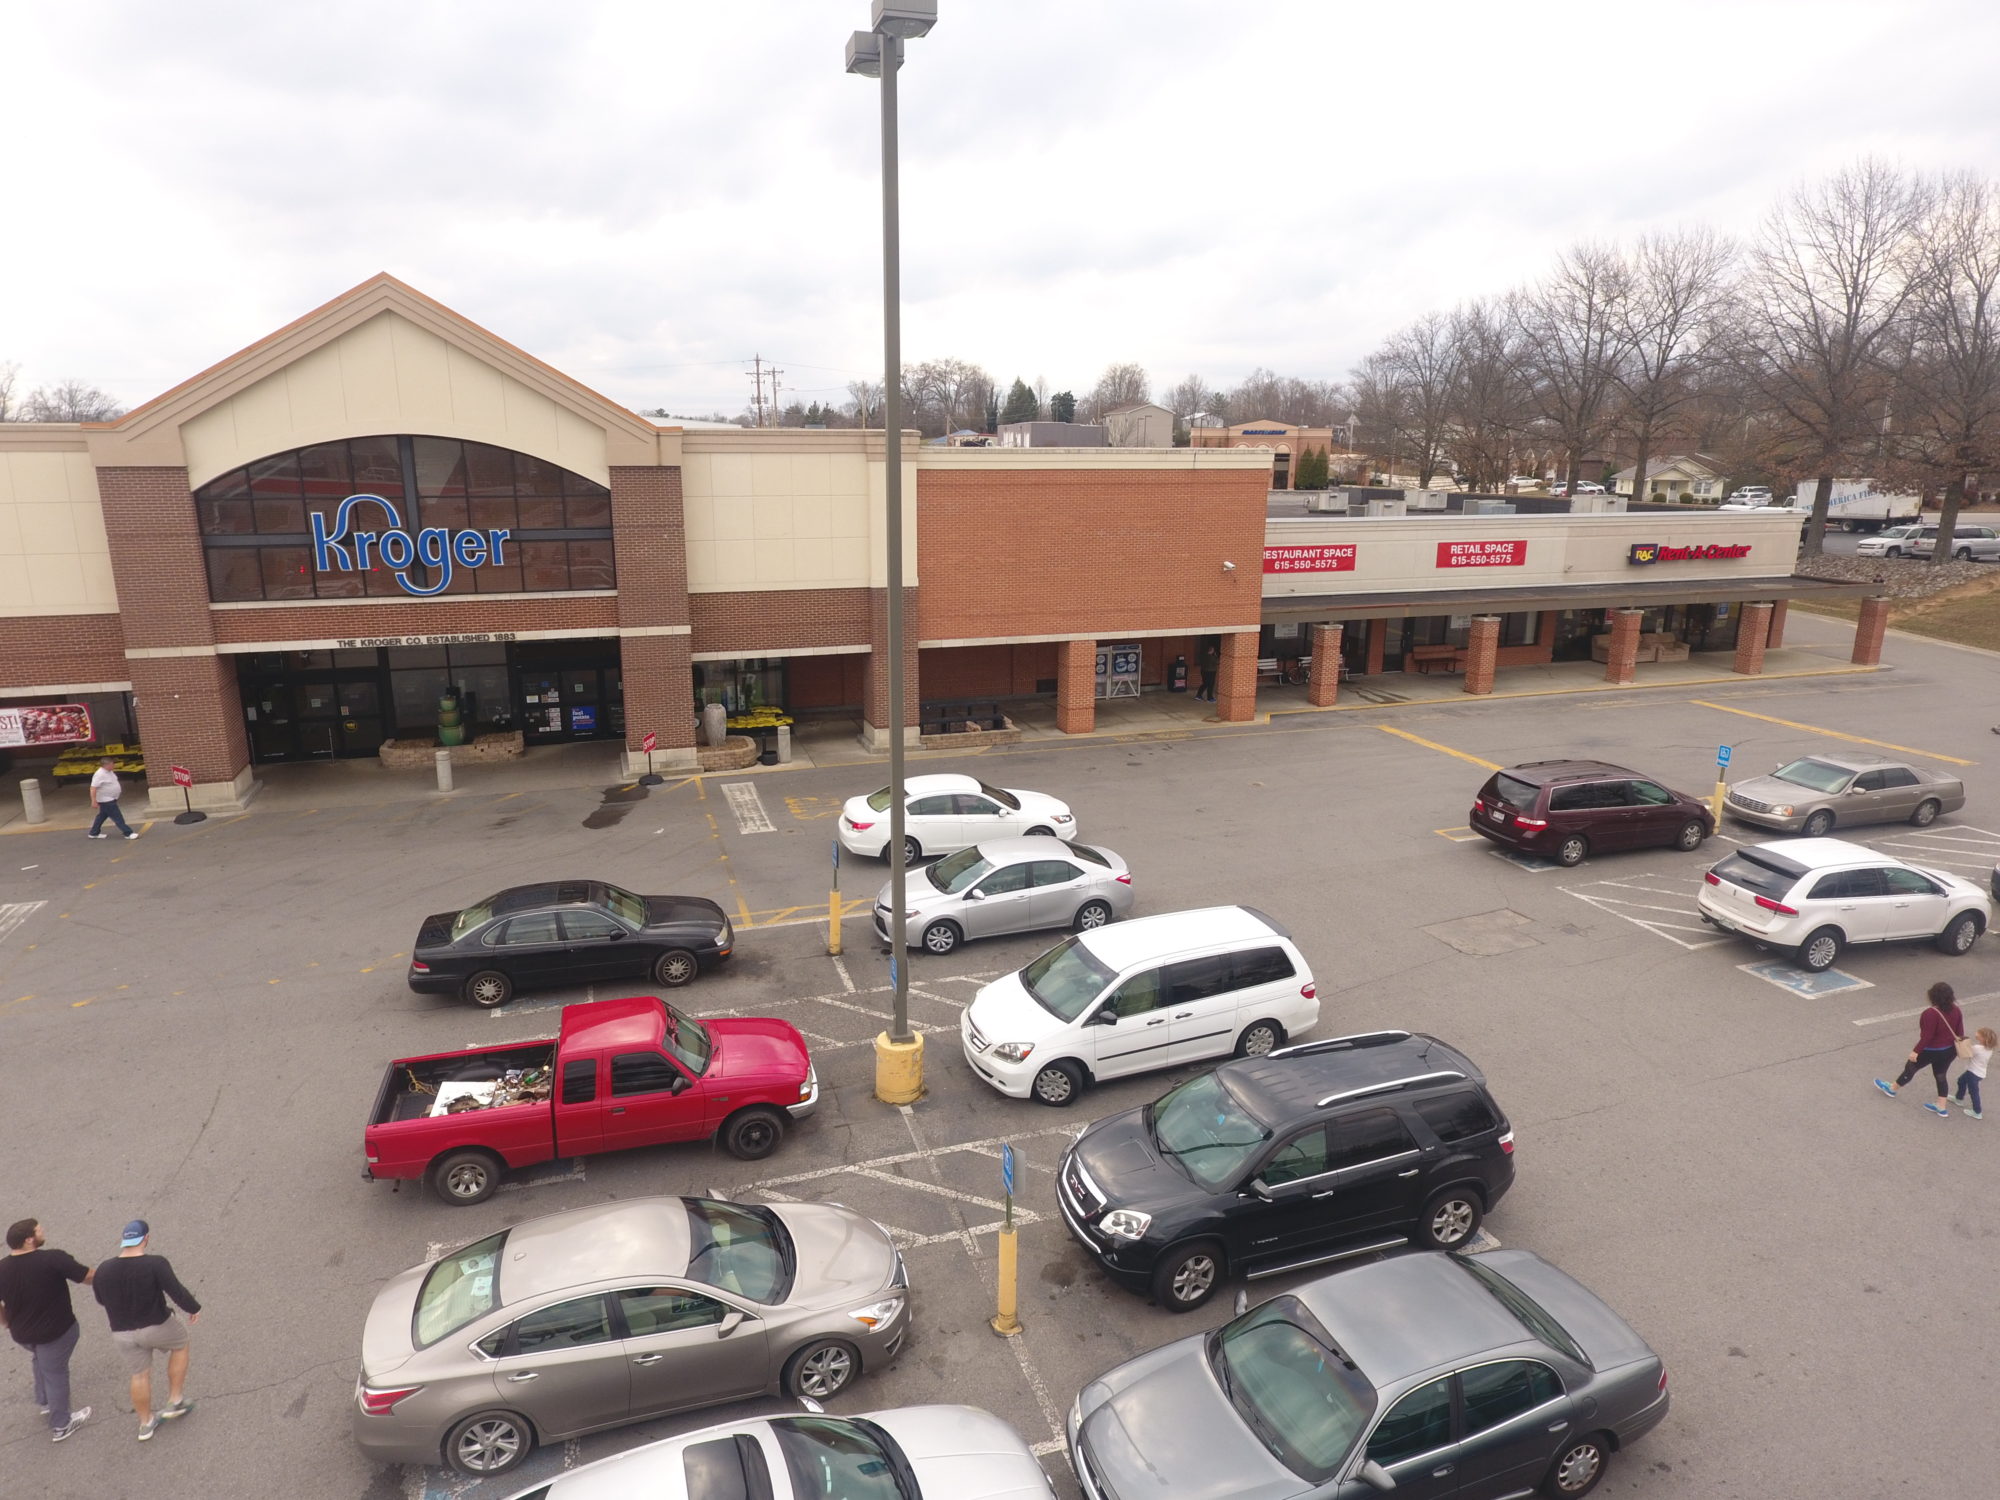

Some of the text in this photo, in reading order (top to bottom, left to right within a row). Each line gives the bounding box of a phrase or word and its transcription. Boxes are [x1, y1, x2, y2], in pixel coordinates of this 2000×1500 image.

[311, 494, 511, 596] Kroger
[1450, 543, 1514, 555] RETAIL SPACE
[1323, 548, 1354, 558] SPACE
[1635, 550, 1654, 562] RAC
[1658, 544, 1752, 560] Rent-A-Center
[1274, 560, 1337, 570] 615-550-5575
[1451, 554, 1512, 565] 615-550-5575
[337, 640, 357, 648] THE
[360, 637, 402, 648] KROGER
[426, 634, 490, 645] ESTABLISHED
[494, 633, 517, 641] 1883
[173, 770, 191, 783] STOP
